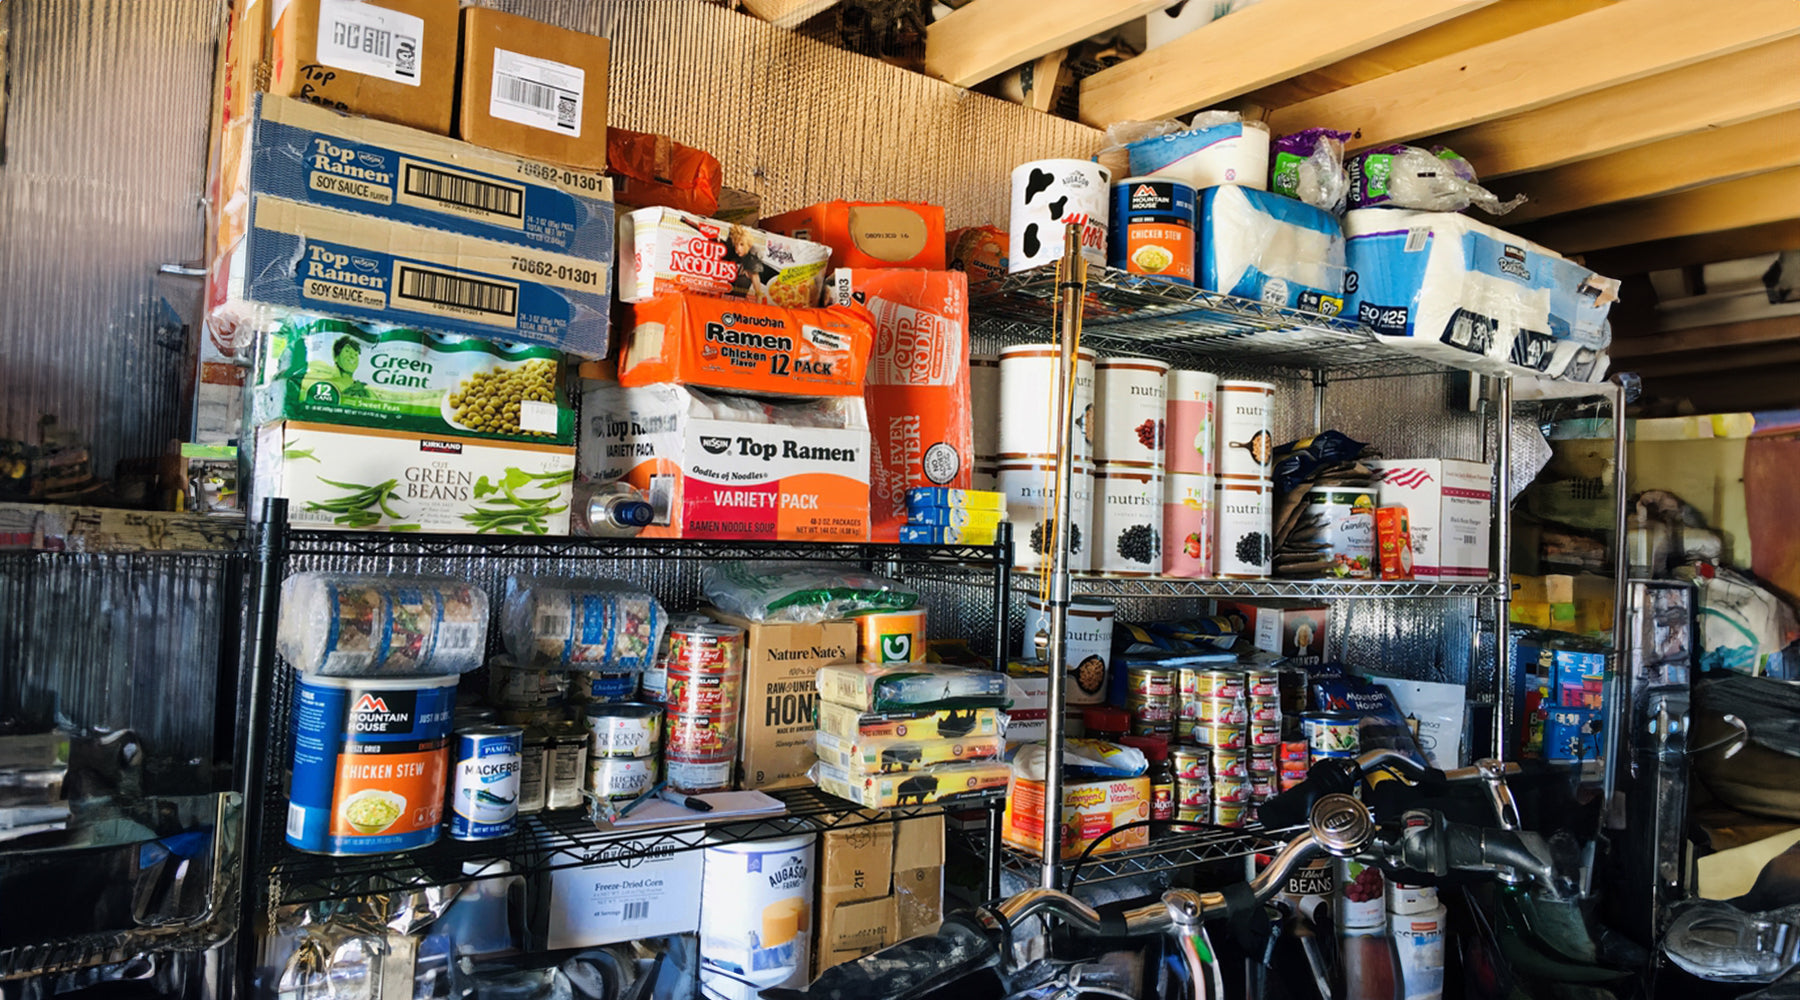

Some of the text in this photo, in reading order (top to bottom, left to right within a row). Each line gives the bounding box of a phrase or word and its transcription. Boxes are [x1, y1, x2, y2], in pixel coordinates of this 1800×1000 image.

[300, 65, 336, 86] Top
[315, 139, 355, 163] Top
[316, 175, 337, 191] SOY
[337, 179, 369, 198] SAUCE
[1132, 196, 1169, 204] MOUNTAIN
[1131, 230, 1181, 240] CHICKEN STEW
[308, 244, 349, 269] Top
[689, 238, 727, 261] CUP
[511, 256, 598, 286] 70662-01301
[671, 251, 738, 282] NOODLES
[679, 276, 714, 287] CHICKEN
[310, 282, 331, 298] SOY
[331, 285, 363, 303] SAUCE
[733, 313, 784, 329] Maruchan
[1361, 305, 1407, 325] 30 425
[706, 322, 793, 351] Ramen
[812, 336, 839, 349] Ramen
[878, 327, 889, 353] NISSIN
[894, 317, 915, 369] CUP
[721, 347, 766, 361] Chicken
[911, 312, 933, 384] NOODLES
[370, 353, 433, 374] Green
[730, 358, 757, 368] Flavor
[770, 353, 833, 376] 12 PACK
[371, 369, 431, 389] Giant
[315, 384, 331, 396] 12
[313, 394, 333, 402] CANS
[357, 400, 400, 411] Sweet Peas
[422, 441, 460, 450] KIRKLAND
[636, 443, 654, 456] PACK
[703, 439, 729, 448] NISSIN
[737, 437, 777, 461] Top
[692, 466, 719, 479] Oodles
[721, 472, 730, 481] of
[889, 416, 906, 517] NOW EVEN
[405, 467, 472, 485] GREEN
[407, 483, 469, 501] BEANS
[713, 490, 819, 509] VARIETY PACK
[690, 521, 775, 533] RAMEN NOODLE SOUP
[833, 518, 861, 526] PACKAGES
[796, 526, 807, 534] NET
[767, 645, 846, 661] Nature Nate's
[767, 682, 786, 694] RAW
[1346, 691, 1387, 701] Mountain
[766, 693, 822, 726] HON
[1355, 701, 1383, 710] House
[349, 712, 408, 722] MOUNTAIN
[419, 713, 433, 723] JUST
[348, 722, 388, 731] HOUSE
[777, 726, 788, 734] MADE
[599, 732, 644, 742] CHCKEN
[364, 745, 381, 753] DRIED
[485, 745, 511, 754] PAMPA
[343, 762, 425, 779] CHICKEN STEW
[608, 773, 648, 783] HICKEN
[1110, 791, 1141, 803] Vitamin C
[768, 866, 808, 888] AUGASON
[854, 870, 865, 888] 21F
[1301, 870, 1324, 879] Black
[595, 880, 664, 892] Freeze-Dried Corn
[782, 882, 801, 890] FARMS
[1289, 877, 1333, 893] BEANS
